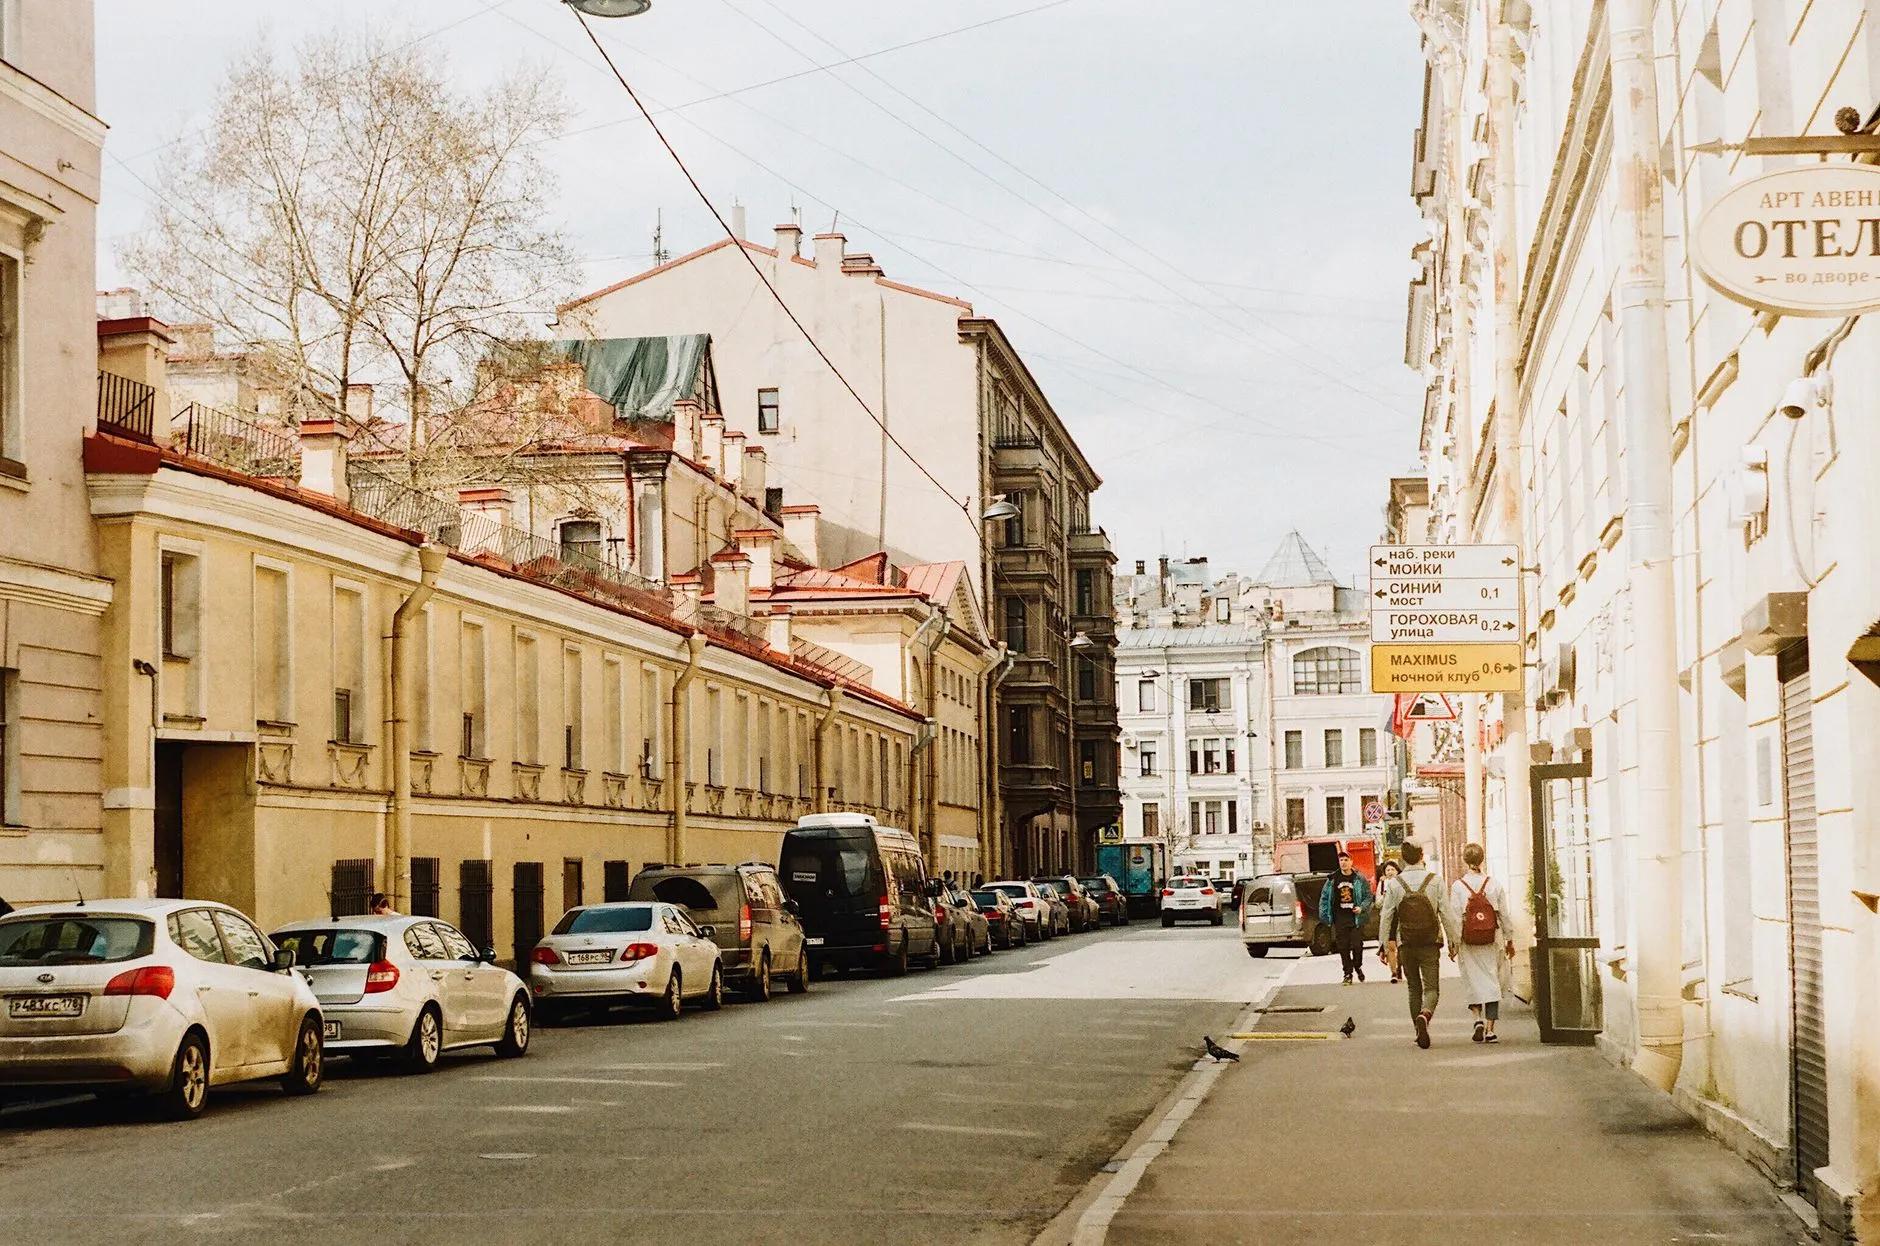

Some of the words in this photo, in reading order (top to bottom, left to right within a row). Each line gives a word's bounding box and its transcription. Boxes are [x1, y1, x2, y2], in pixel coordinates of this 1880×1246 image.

[1760, 191, 1804, 209] АРТ
[1811, 189, 1880, 207] АВЕН
[1733, 218, 1880, 259] ОТЕЛ
[1785, 273, 1806, 284] во
[1812, 271, 1870, 287] дворе
[1389, 548, 1419, 560] наб.
[1423, 550, 1455, 561] реки
[1389, 562, 1442, 575] МОЙКИ
[1389, 580, 1442, 594] СИНИЙ
[1480, 587, 1499, 600] 0,1
[1389, 597, 1424, 606] мост
[1389, 614, 1478, 625] ГОРОХОВАЯ
[1480, 620, 1501, 632] 0,2
[1390, 628, 1434, 640] улица
[1390, 654, 1457, 666] MAXIMUS
[1482, 662, 1502, 675] 0,6
[1391, 671, 1444, 683] ночной
[1447, 669, 1480, 685] клуб
